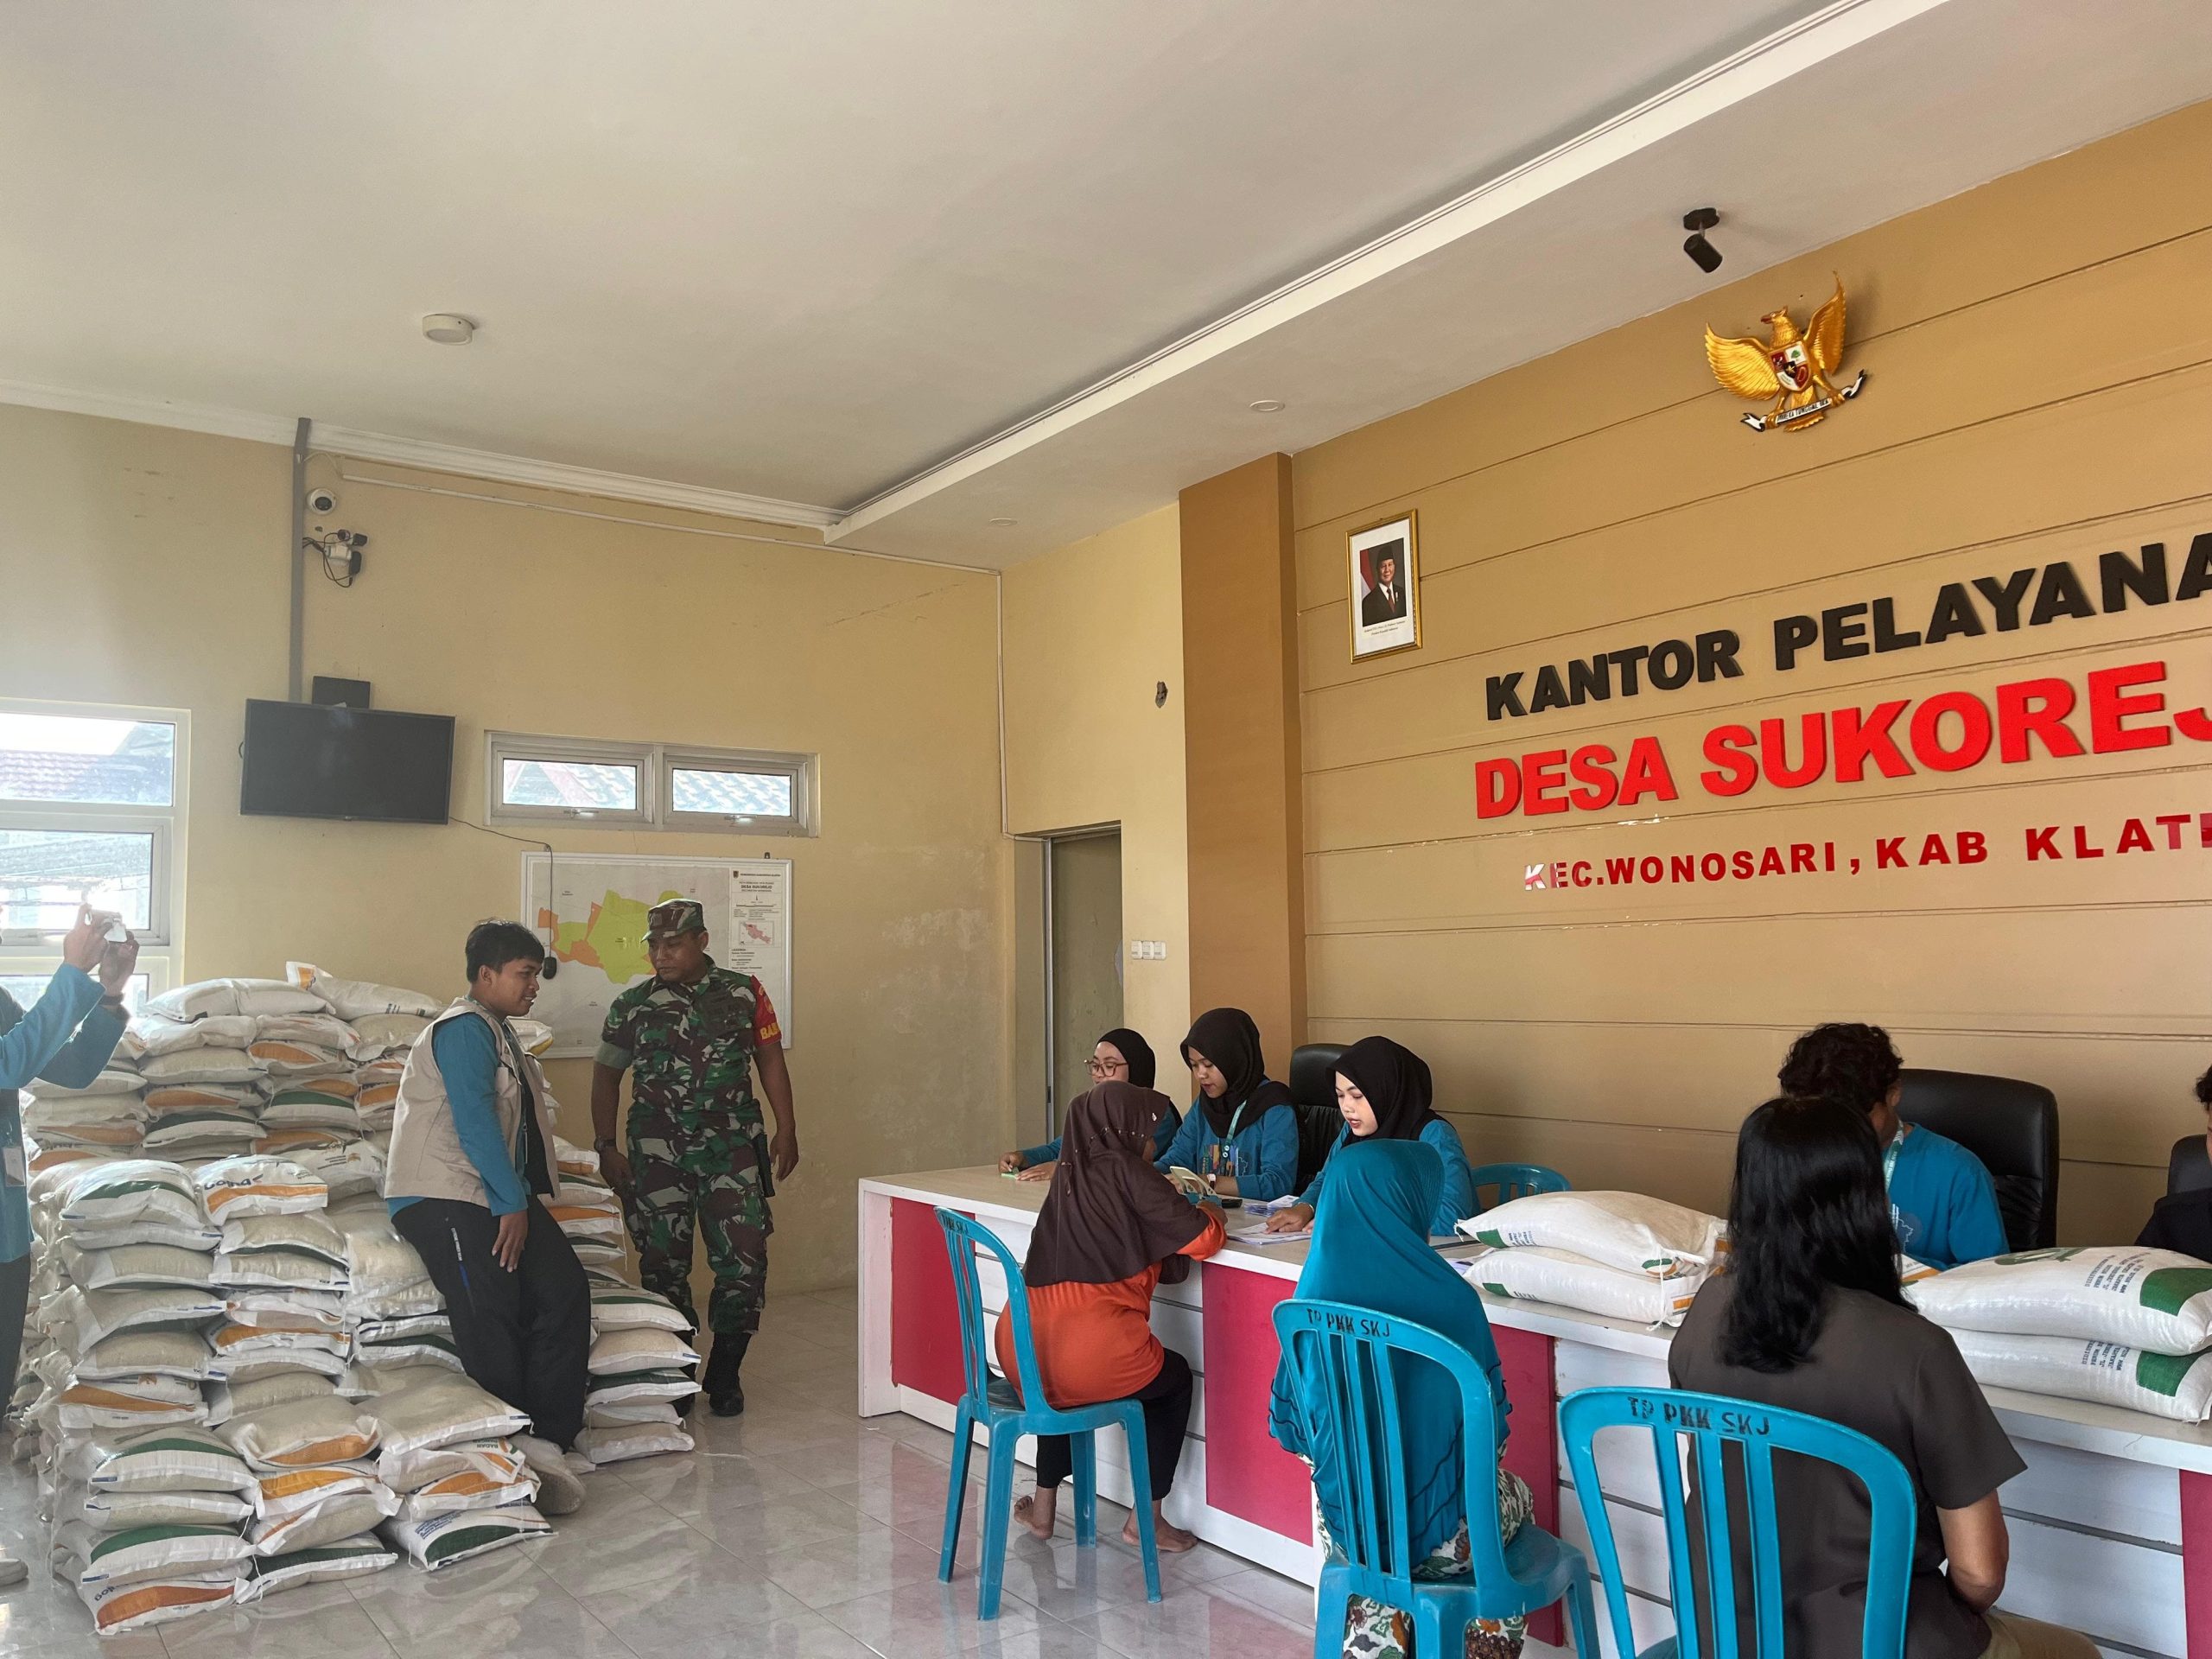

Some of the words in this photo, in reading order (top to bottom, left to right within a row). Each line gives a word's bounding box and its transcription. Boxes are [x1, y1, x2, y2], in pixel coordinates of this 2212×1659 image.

[1486, 628, 1744, 721] KANTOR
[1474, 736, 1678, 819] DESA
[1877, 832, 1987, 870] KAB
[1325, 1313, 1355, 1333] PKK
[1360, 1319, 1390, 1338] SKJ
[1663, 1402, 1712, 1430] PKK
[1721, 1411, 1770, 1435] SKJ
